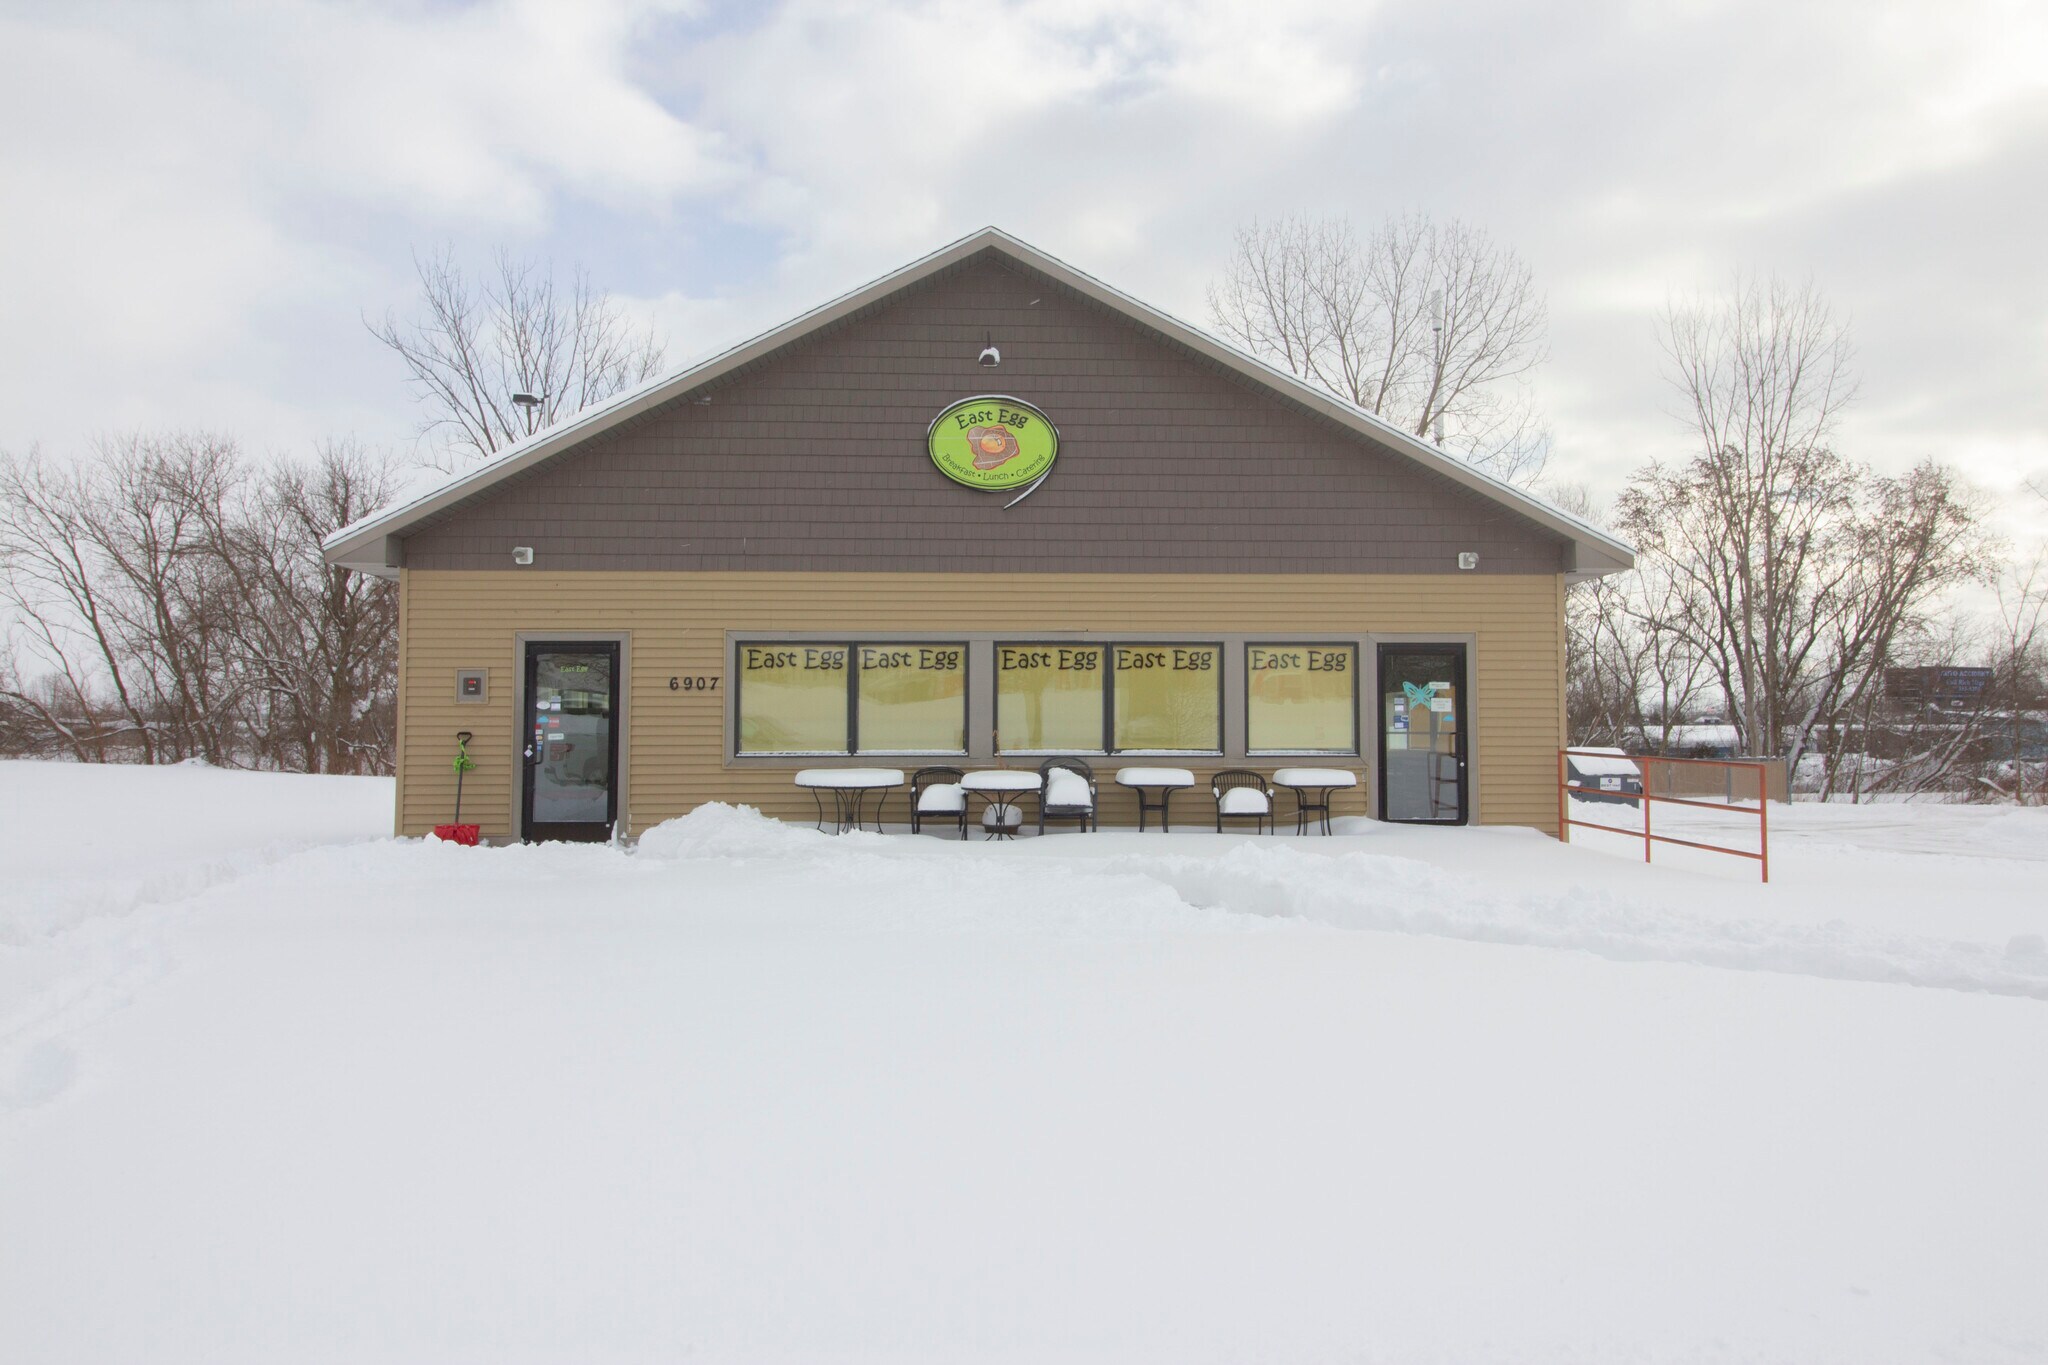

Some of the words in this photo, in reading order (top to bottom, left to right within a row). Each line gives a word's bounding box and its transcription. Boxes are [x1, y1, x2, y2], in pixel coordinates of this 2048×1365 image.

[955, 410, 993, 430] East
[998, 408, 1029, 429] Egg
[942, 453, 976, 477] Breakfast
[983, 472, 1009, 481] Lunch
[1016, 454, 1045, 477] Catering
[746, 649, 798, 669] East
[804, 649, 845, 670] Egg
[862, 649, 912, 669] East
[919, 649, 959, 670] Egg
[1001, 649, 1051, 669] East
[1057, 649, 1098, 670] Egg
[1116, 649, 1166, 669] East
[1172, 649, 1212, 670] Egg
[1251, 650, 1300, 670] East
[1307, 650, 1347, 671] Egg
[669, 676, 720, 691] 6907
